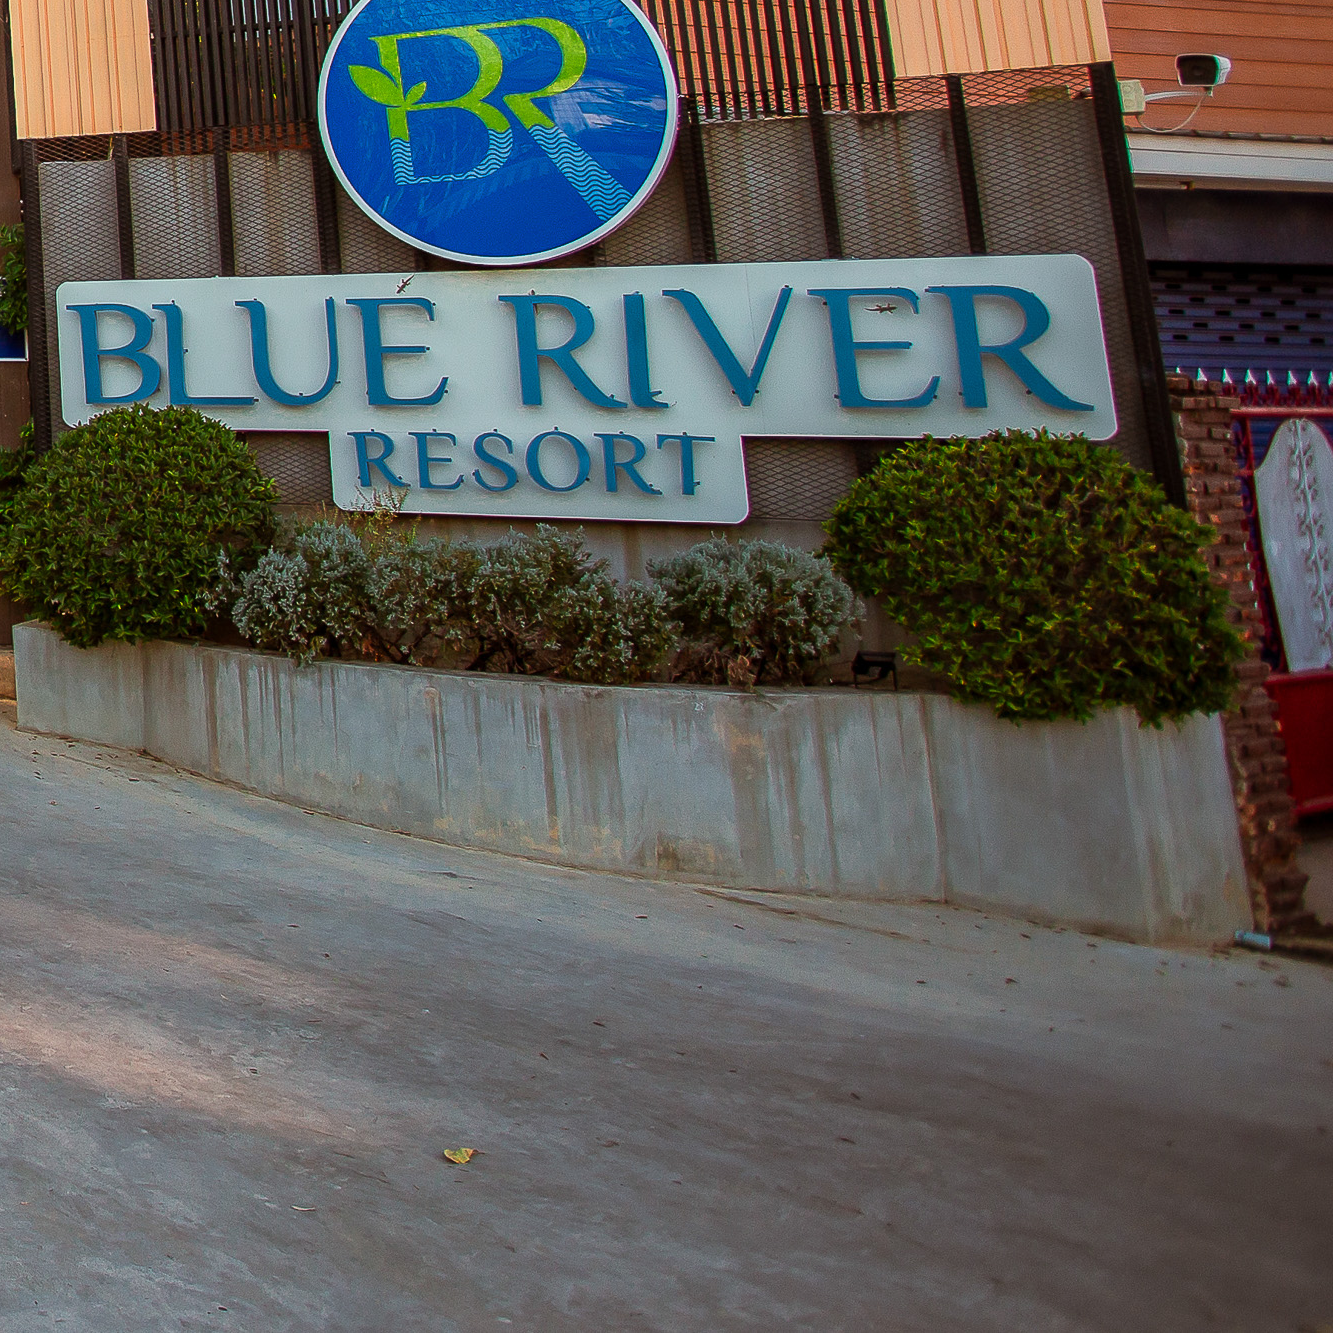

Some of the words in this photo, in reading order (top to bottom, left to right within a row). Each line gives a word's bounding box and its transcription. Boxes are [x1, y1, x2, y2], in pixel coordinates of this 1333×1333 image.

[65, 296, 450, 407] BLUE
[497, 285, 1095, 412] RIVER
[346, 428, 716, 496] RESORT
